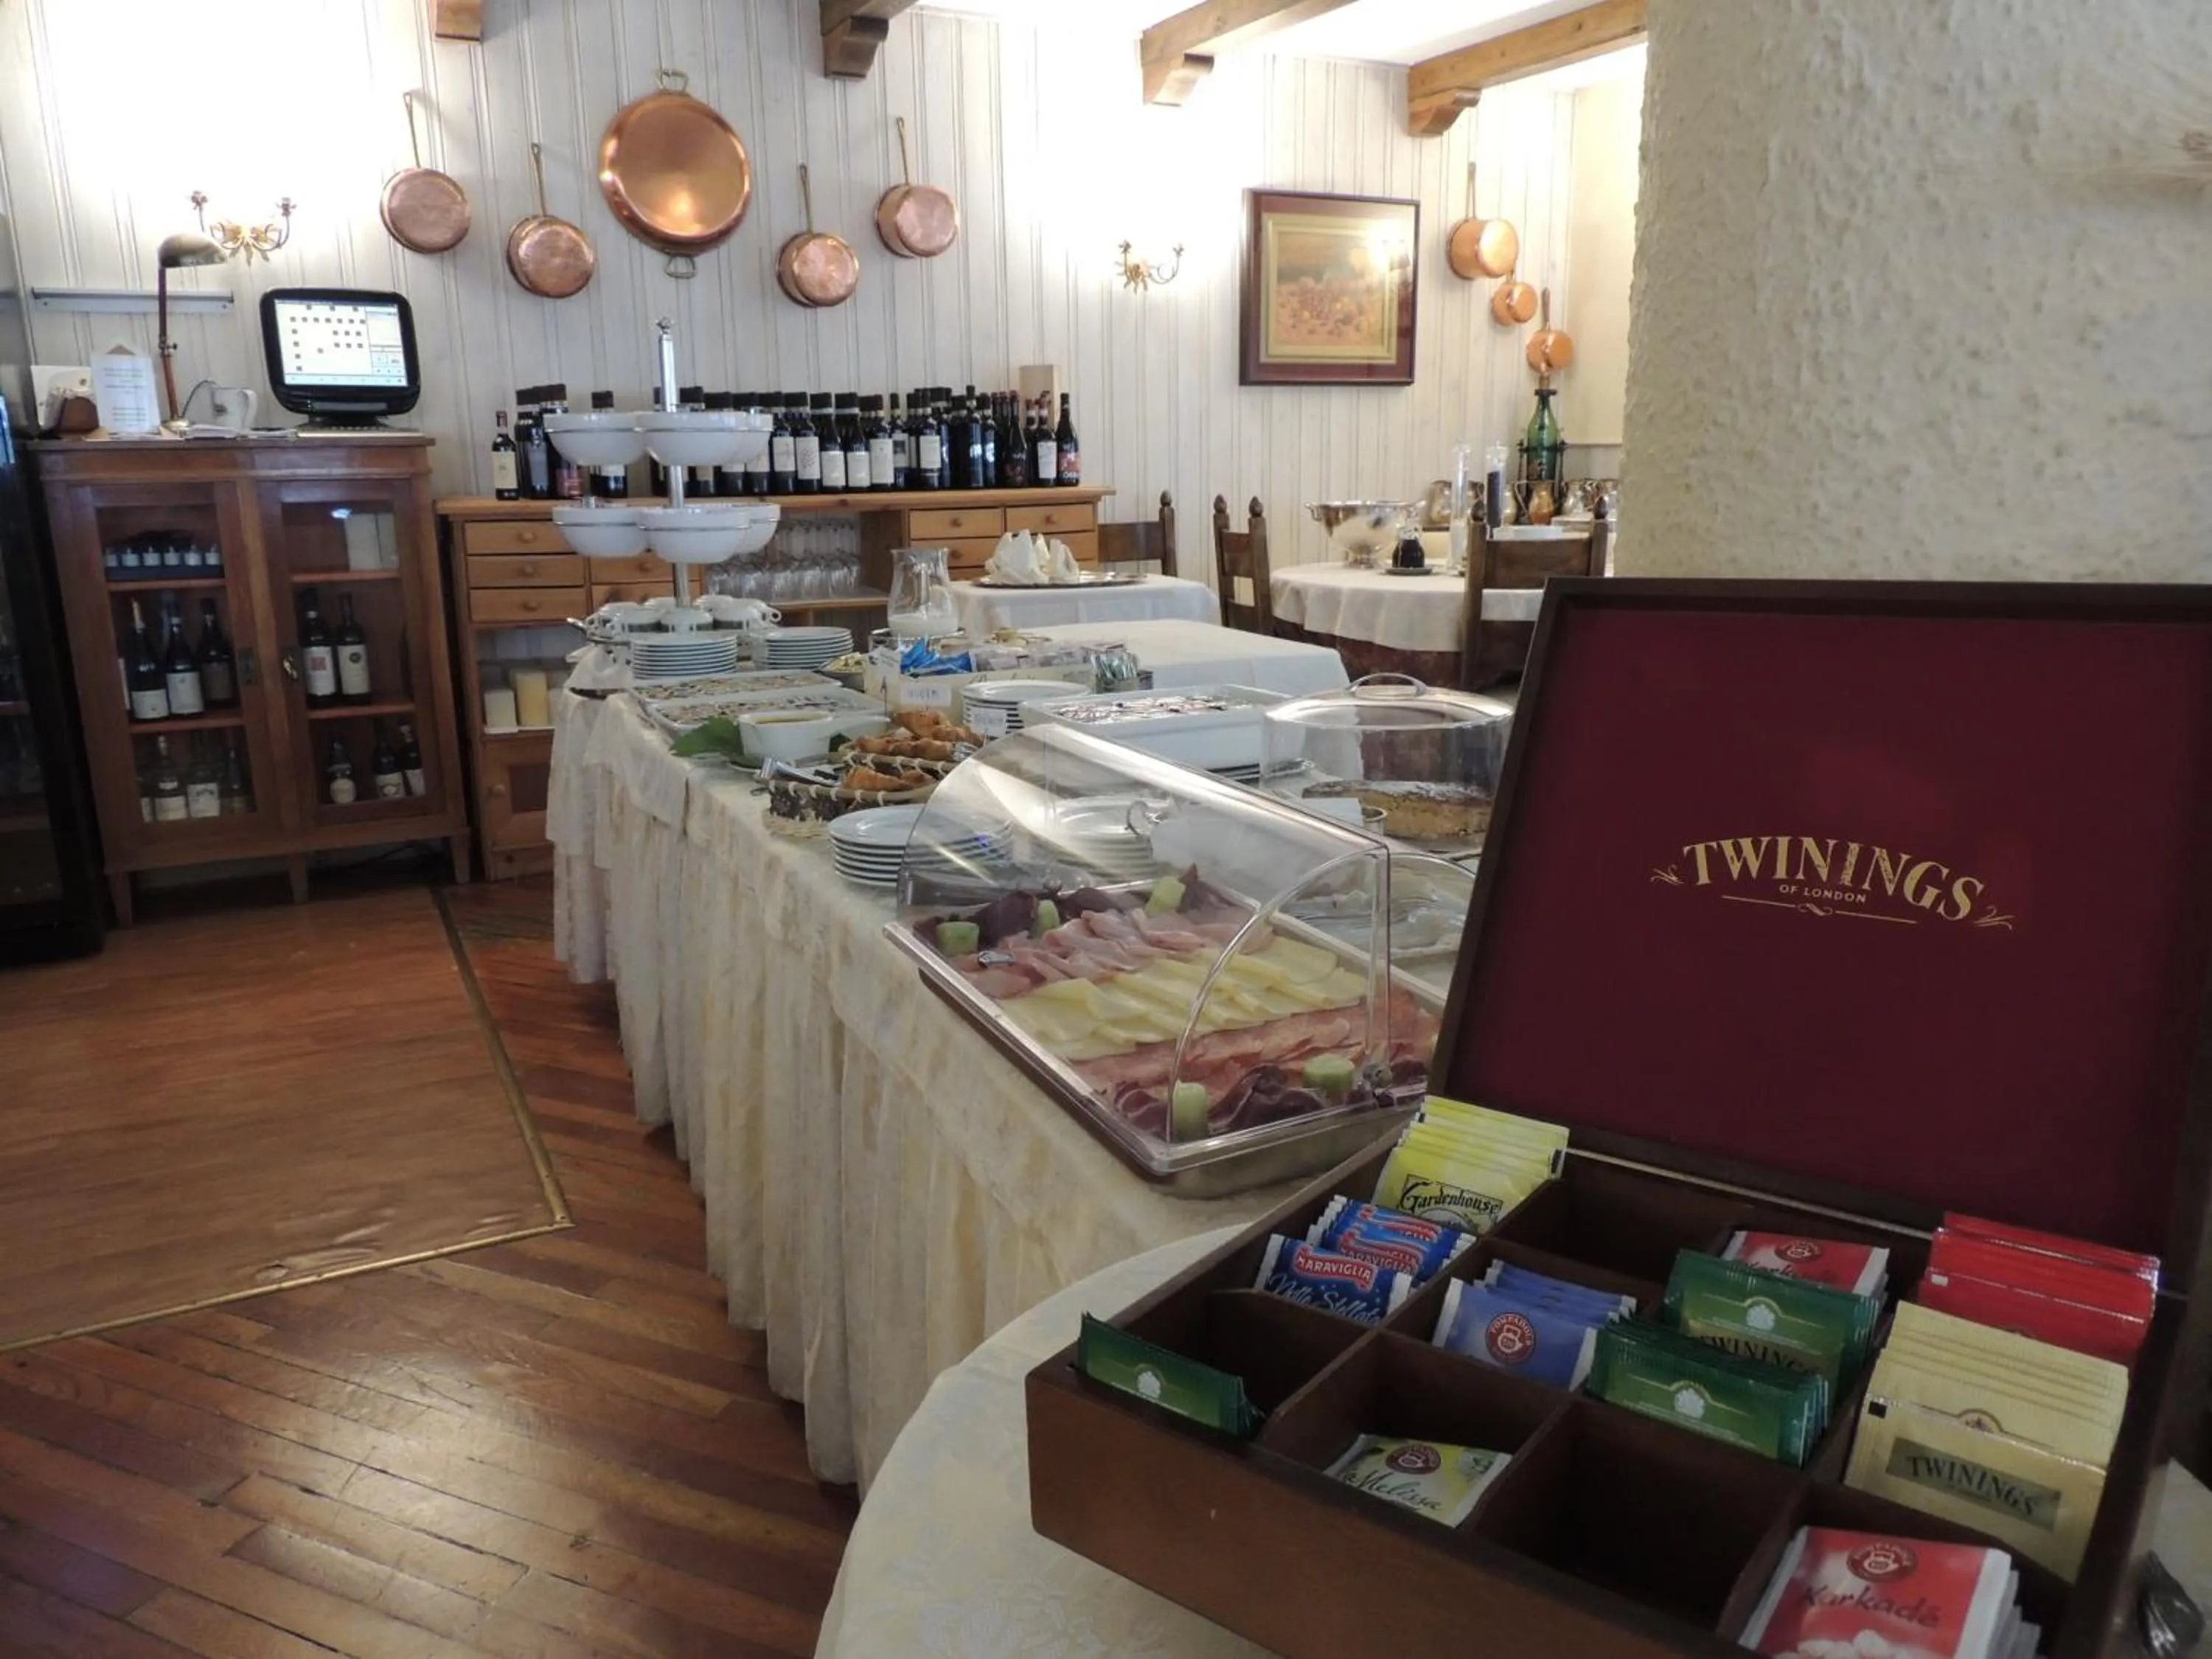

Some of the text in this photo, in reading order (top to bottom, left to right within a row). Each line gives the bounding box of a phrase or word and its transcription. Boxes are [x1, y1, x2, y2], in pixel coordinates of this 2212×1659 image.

[1683, 835, 1986, 922] TWININGS
[1778, 883, 1867, 904] OF LONDON
[1397, 1181, 1499, 1214] Gardenhouse
[1297, 1255, 1372, 1281] MARAVIGLIA
[1906, 1455, 2038, 1514] TWININGS
